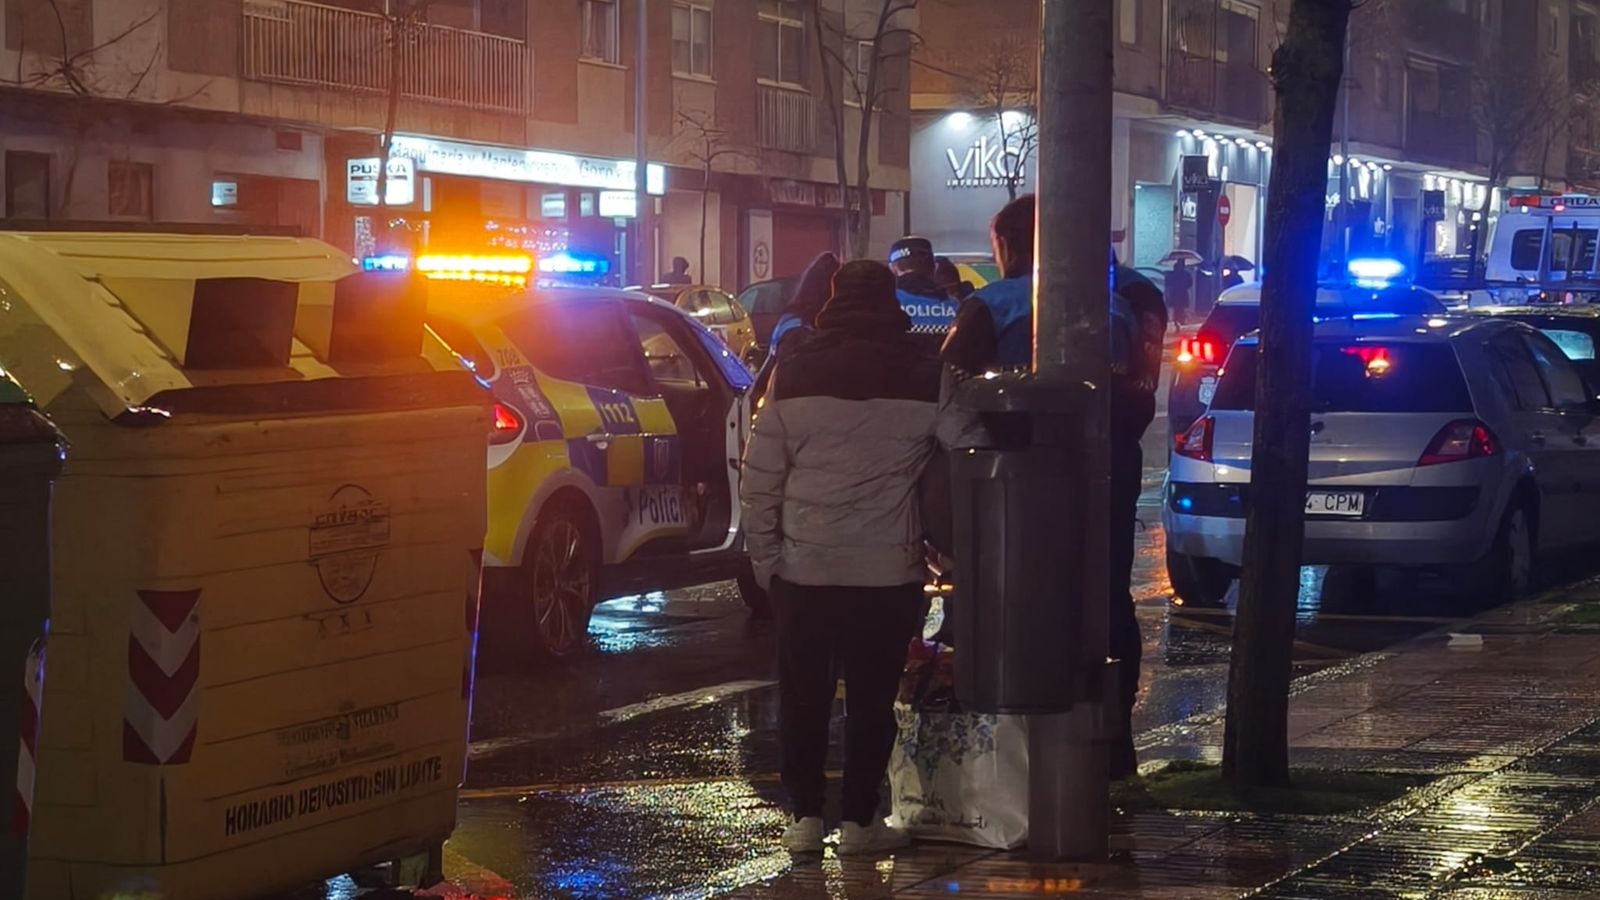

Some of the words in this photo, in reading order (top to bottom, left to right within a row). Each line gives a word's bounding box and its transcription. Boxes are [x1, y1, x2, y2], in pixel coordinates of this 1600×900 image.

[1325, 494, 1360, 511] CPM
[225, 793, 294, 836] HORARIO
[373, 767, 397, 797] SIN
